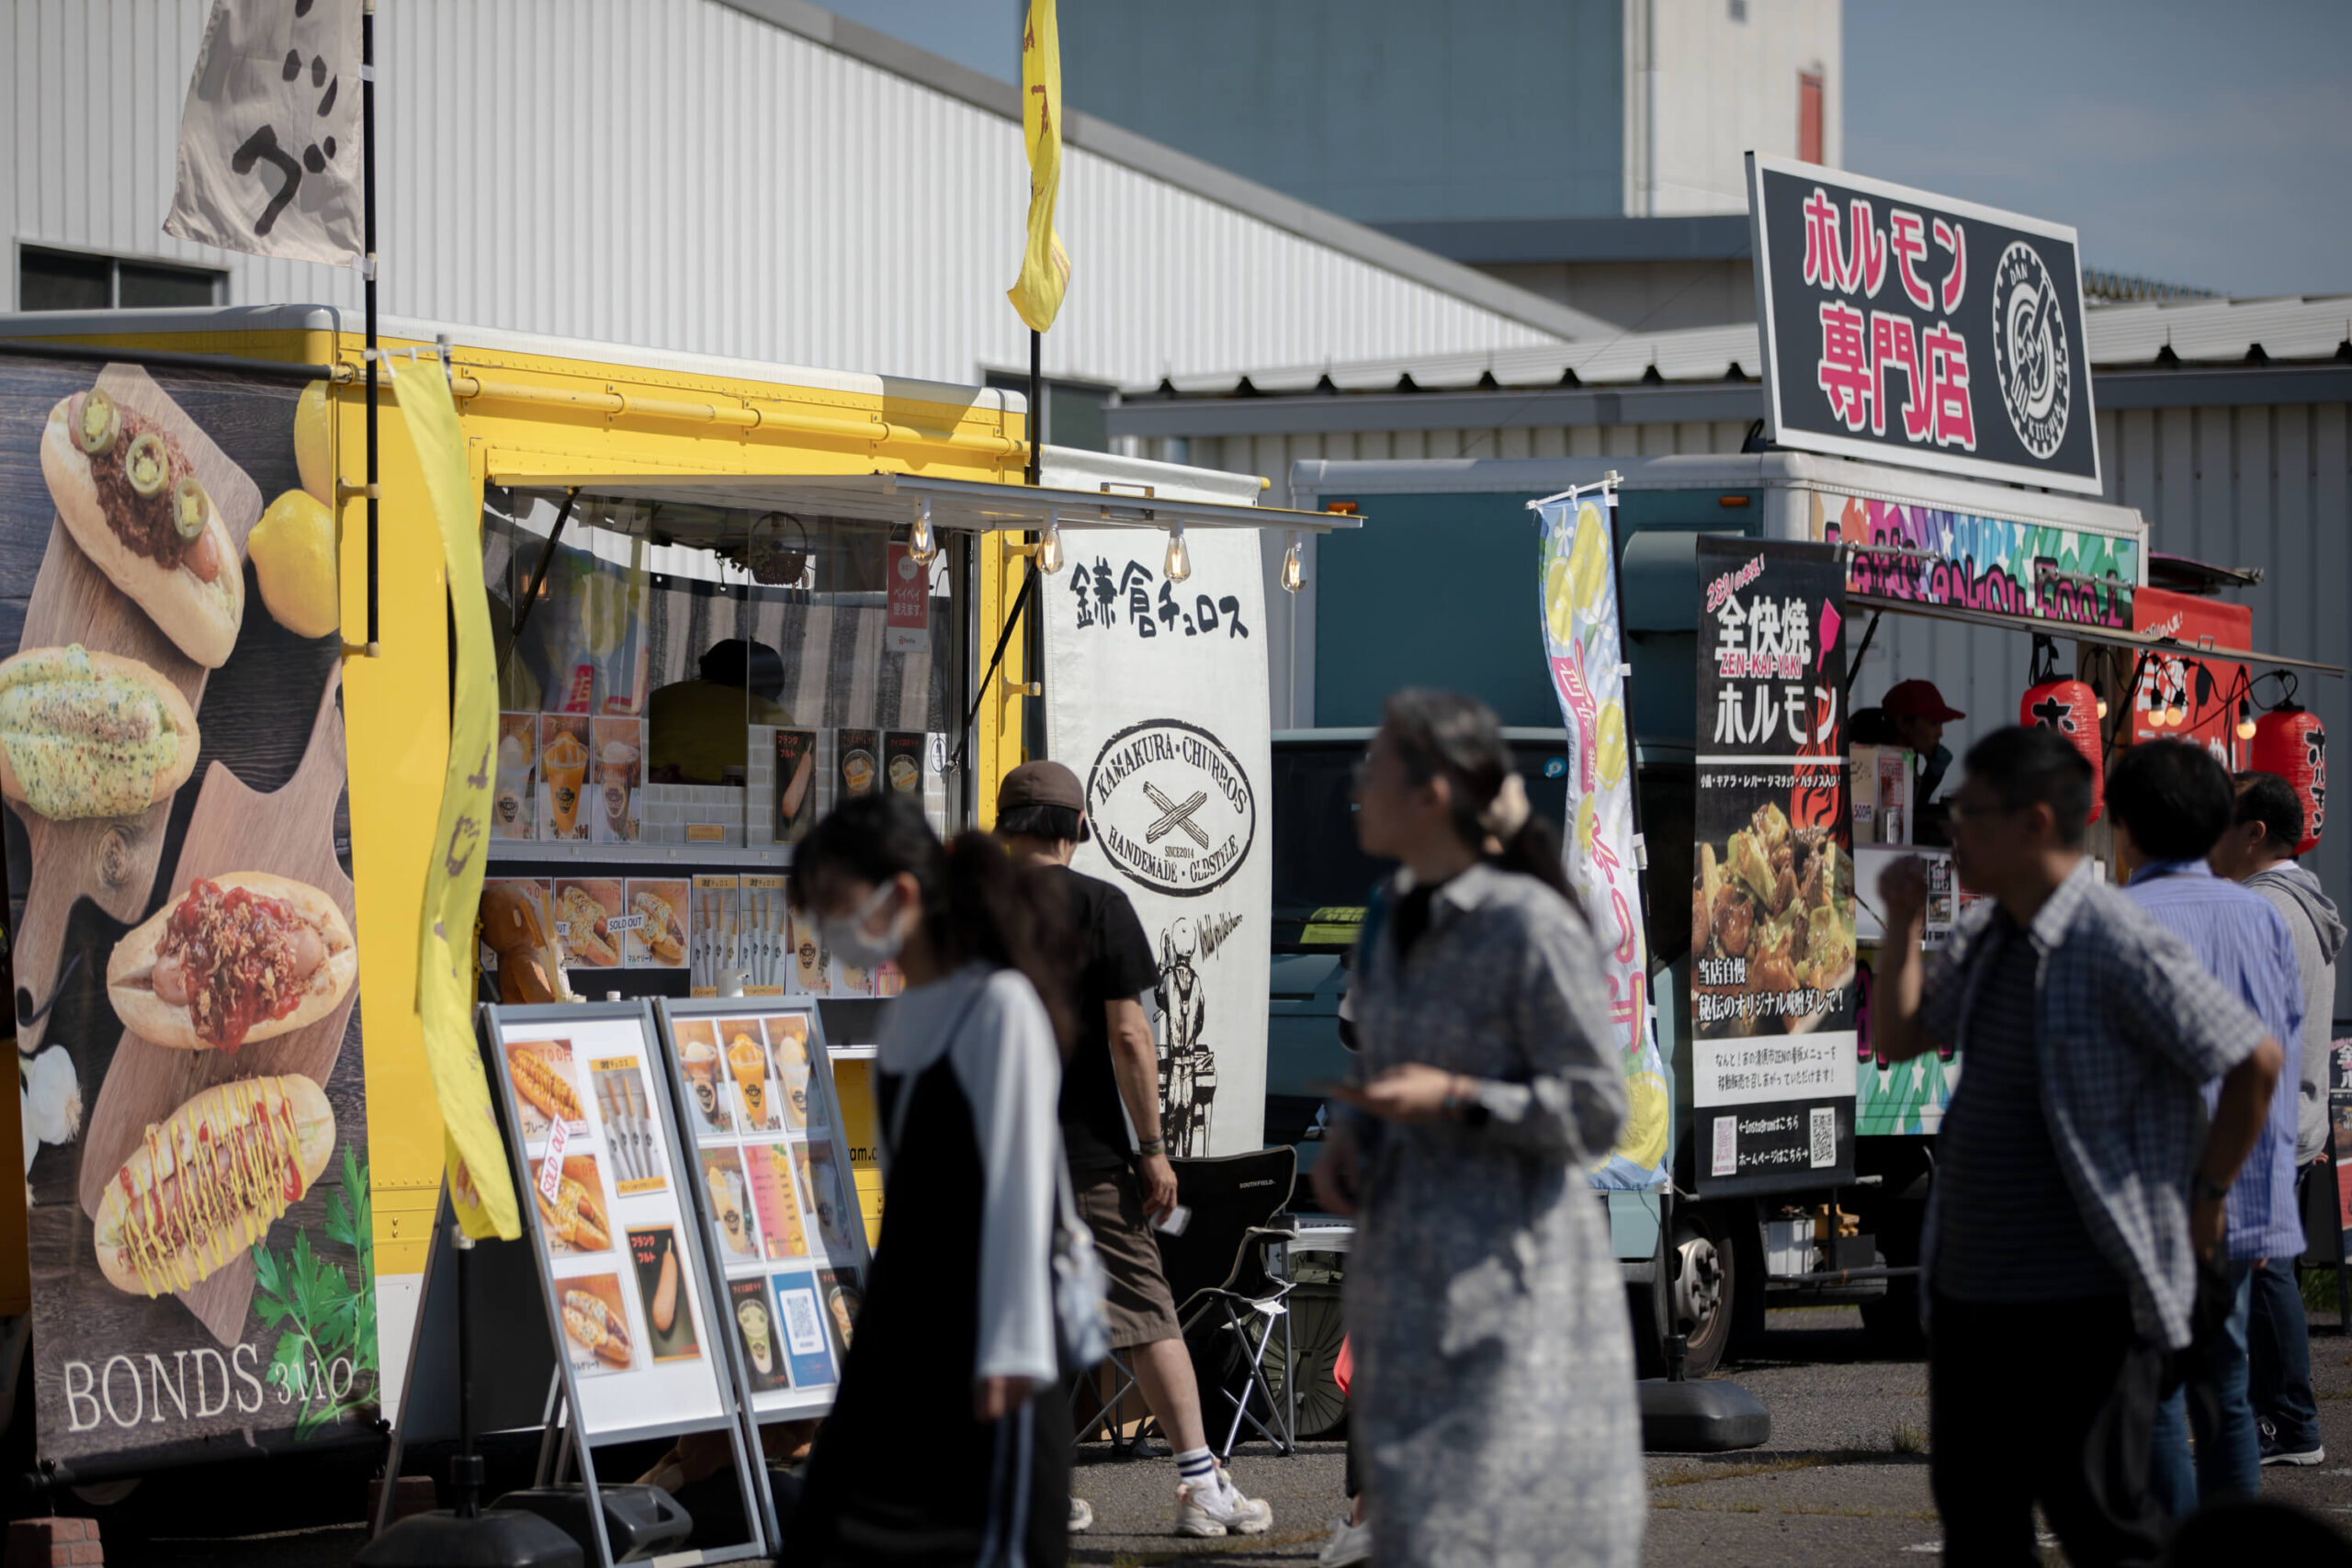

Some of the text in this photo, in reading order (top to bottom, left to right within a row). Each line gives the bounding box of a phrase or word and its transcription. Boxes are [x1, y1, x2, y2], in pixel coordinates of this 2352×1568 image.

[1803, 186, 1967, 316] ホルモン
[2009, 263, 2029, 287] DAN
[1816, 299, 1977, 452] 専門店
[2027, 399, 2063, 441] KITCHEN
[1069, 556, 1250, 639] 鎌倉チュロス
[1714, 594, 1812, 665] 全快焼
[1719, 652, 1804, 680] ZEN-KAI-YAKI
[1713, 682, 1838, 746] ホルモン
[1095, 733, 1248, 814] KAMAKURA CHURROS
[609, 916, 643, 931] SOLD OUT
[1698, 958, 1747, 987] 当店自慢
[542, 1119, 568, 1199] SOLD OUT
[630, 1234, 655, 1248] フランク
[637, 1252, 656, 1264] フルト
[64, 1342, 355, 1433] BONDS 3110
